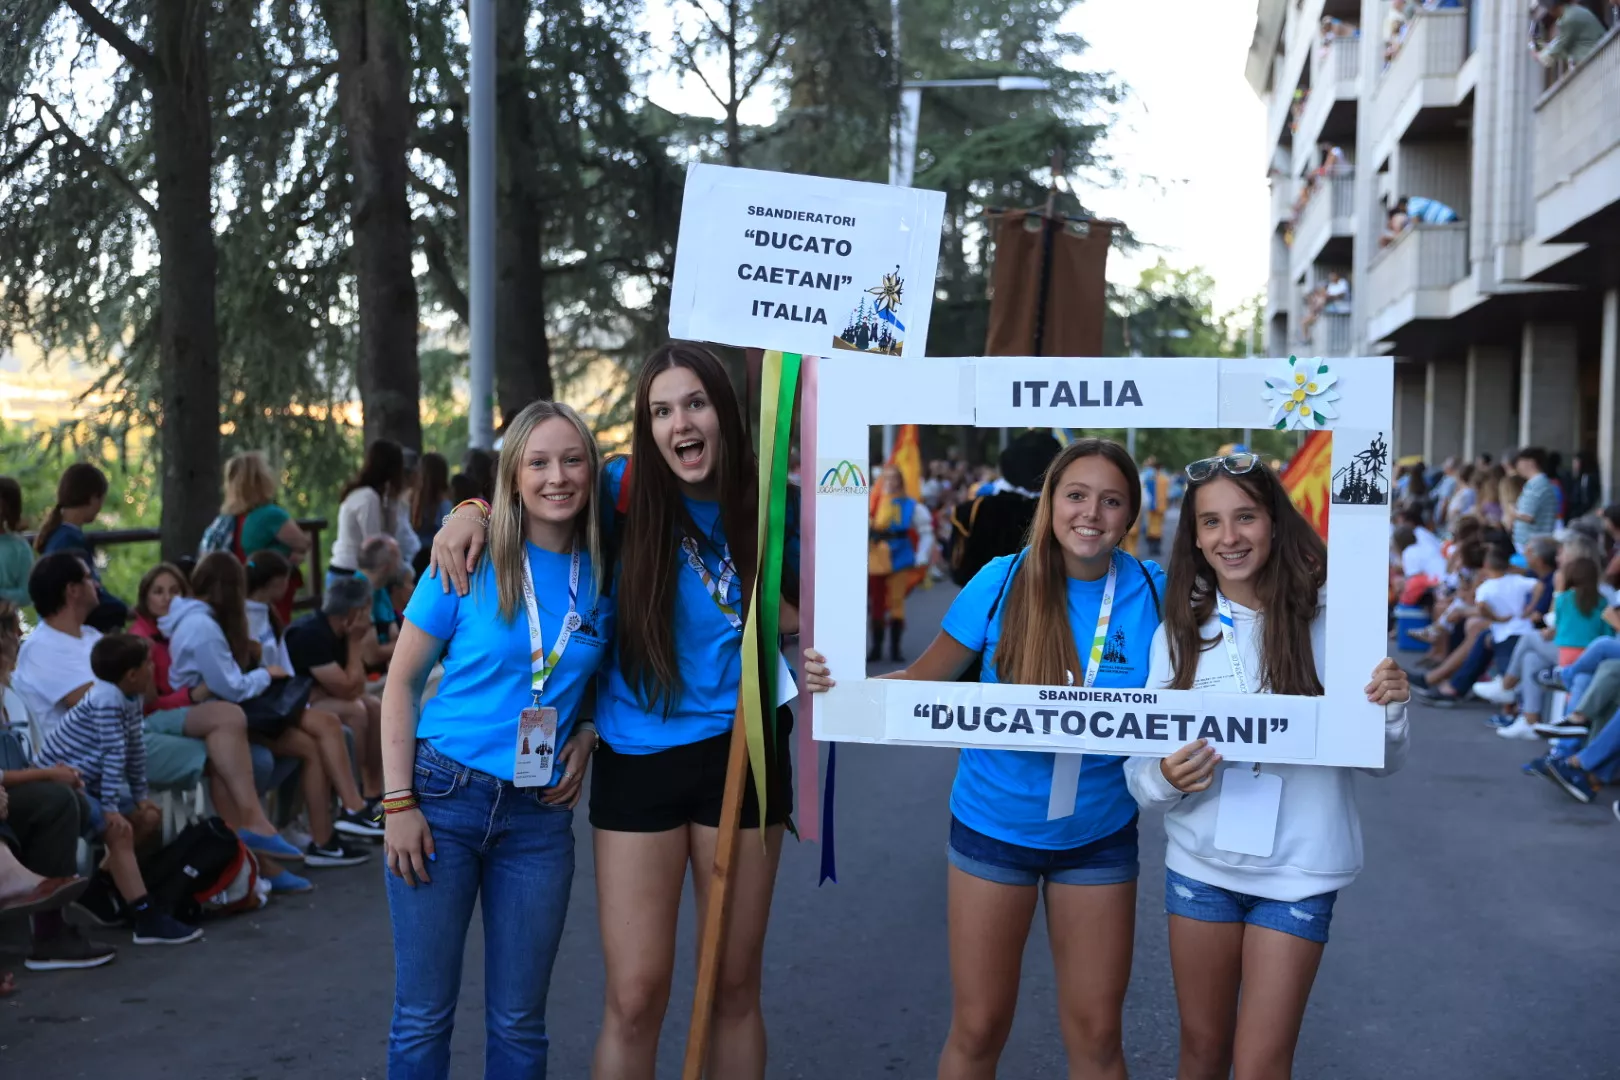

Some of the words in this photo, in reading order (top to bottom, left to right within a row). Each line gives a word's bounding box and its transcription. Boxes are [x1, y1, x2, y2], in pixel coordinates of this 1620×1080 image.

[747, 205, 856, 227] SBANDIERATORI
[744, 228, 852, 257] “DUCATO
[737, 263, 853, 291] CAETANI”
[751, 299, 828, 325] ITALIA
[1012, 379, 1144, 408] ITALIA
[1038, 689, 1158, 704] SBANDIERATORI
